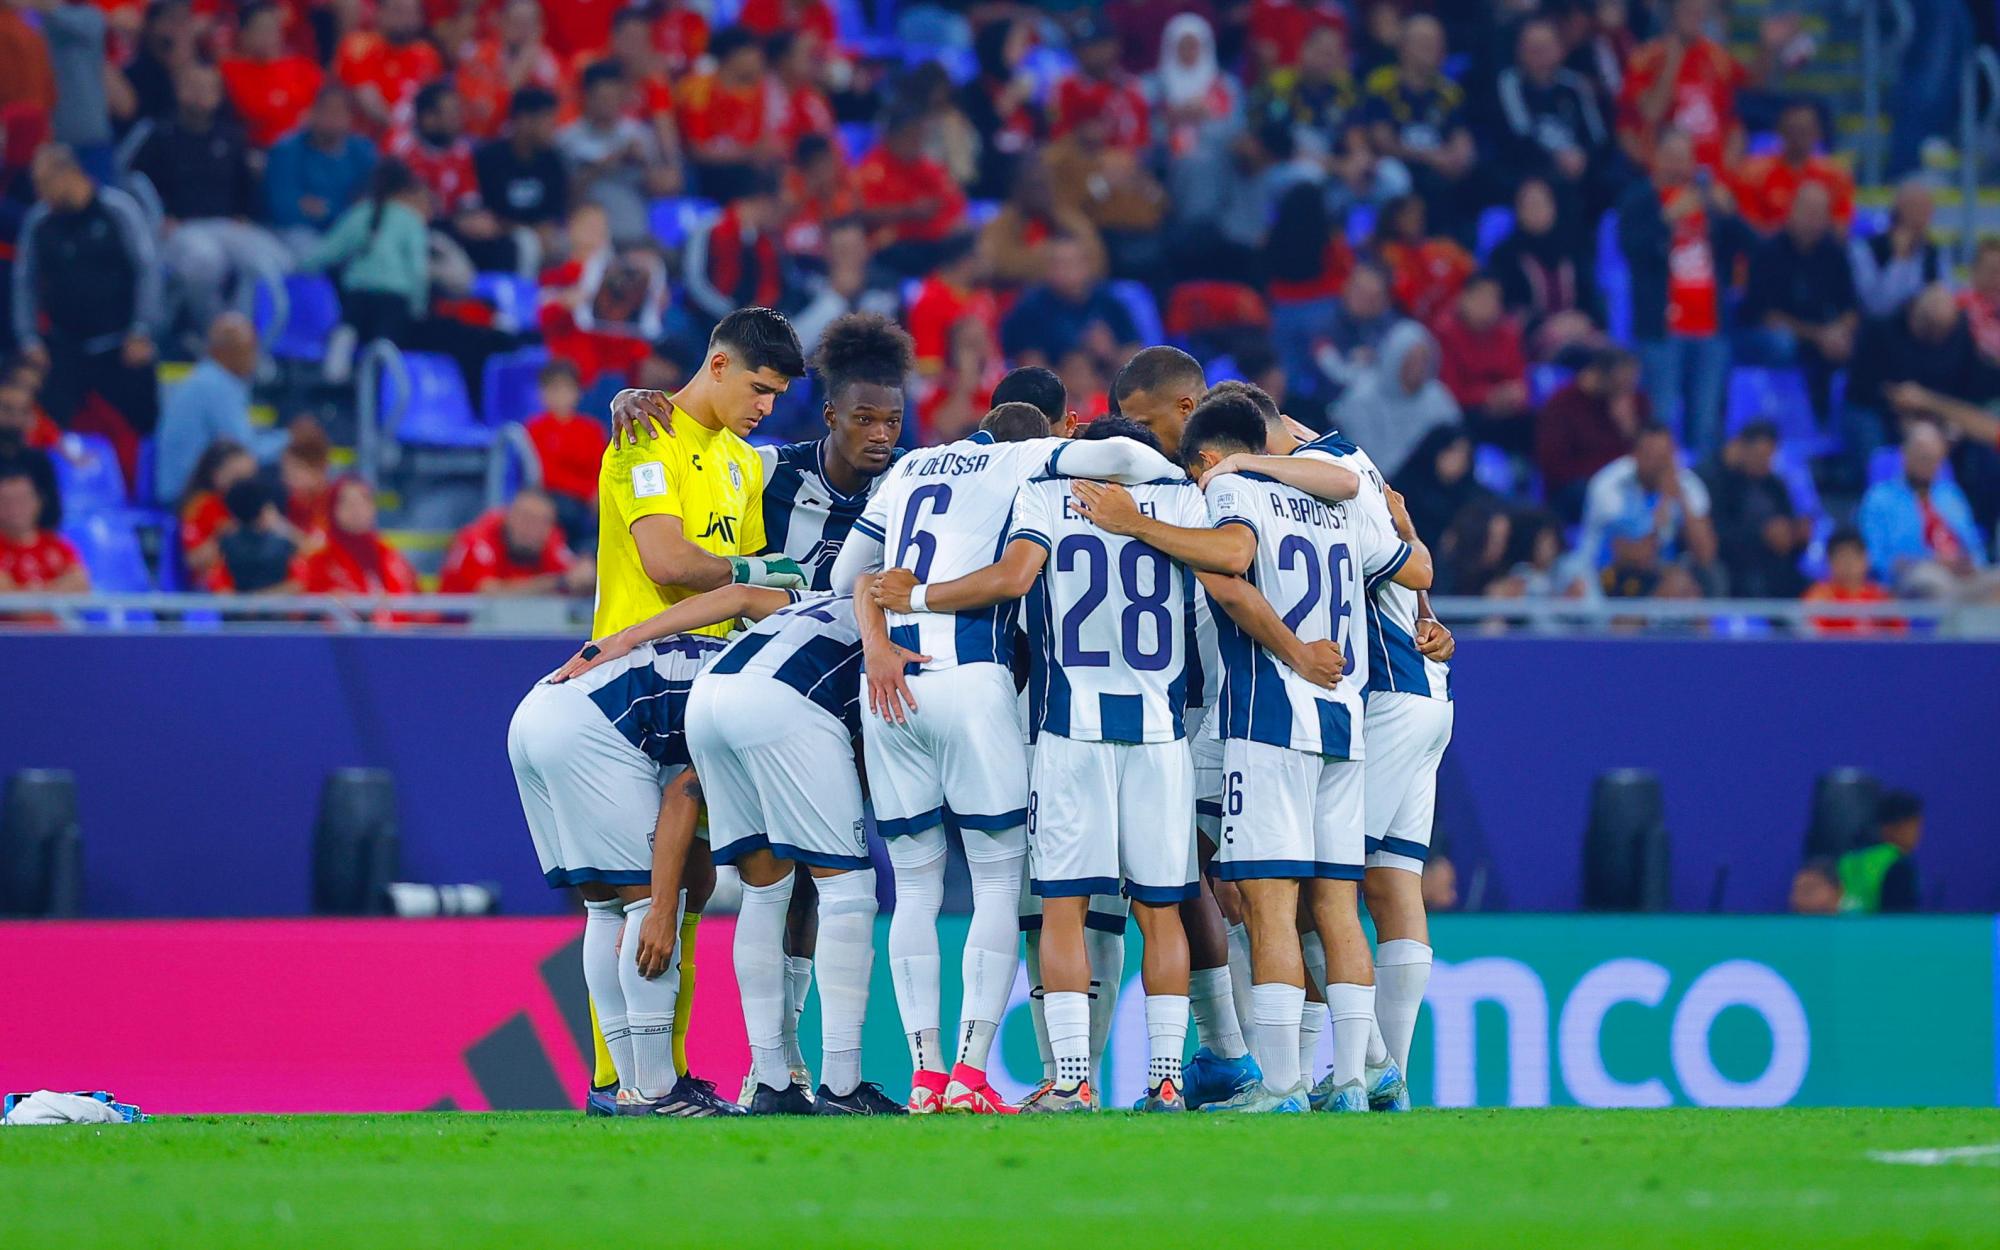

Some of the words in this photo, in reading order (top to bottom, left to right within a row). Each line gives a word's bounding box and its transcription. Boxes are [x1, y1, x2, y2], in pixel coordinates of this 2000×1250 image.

[919, 453, 989, 476] DEOSSA
[1270, 492, 1290, 519] A.
[1287, 498, 1349, 530] BAUTISA
[895, 483, 952, 584] 6
[1057, 534, 1172, 671] 28
[1278, 534, 1355, 676] 26
